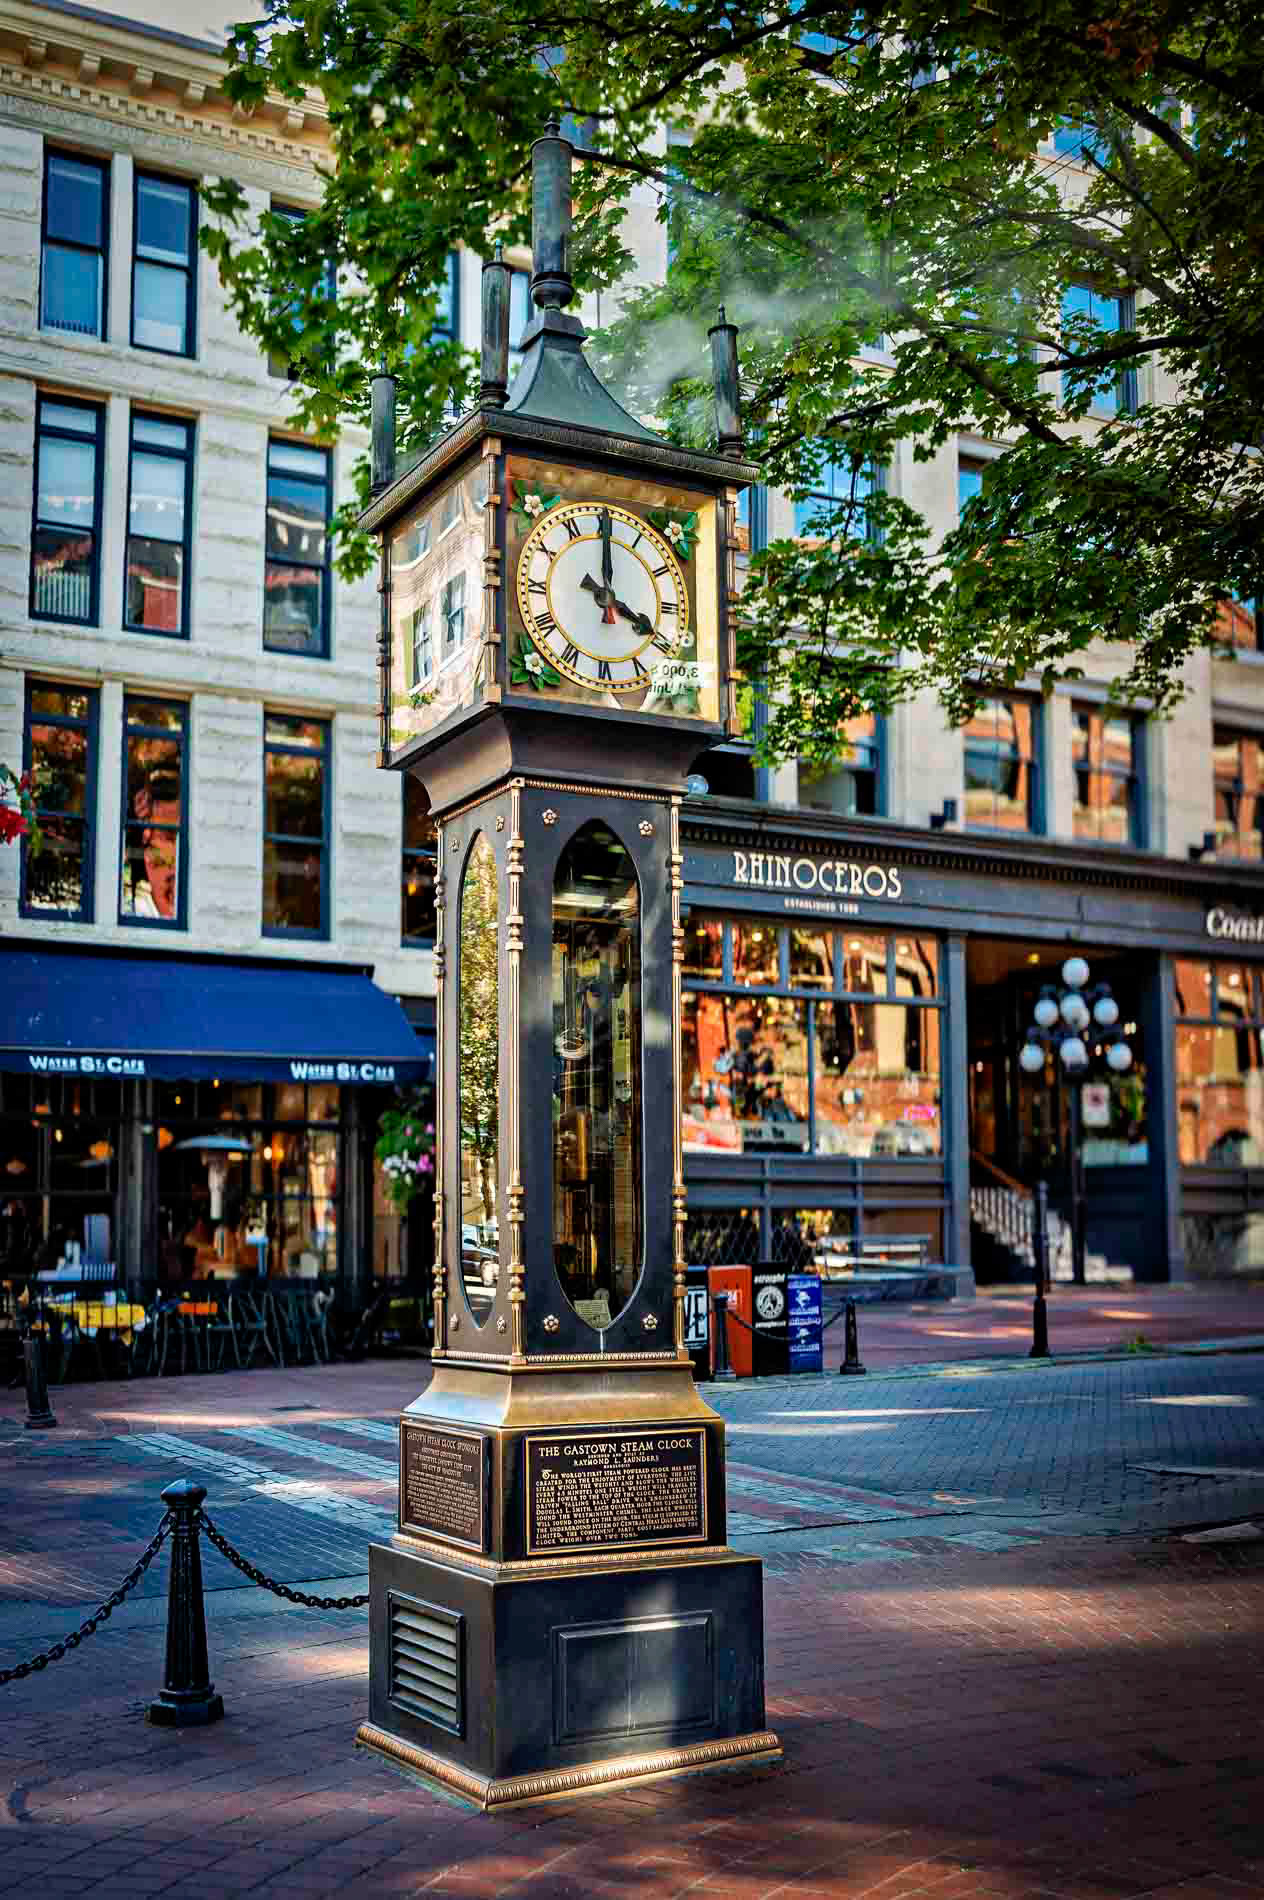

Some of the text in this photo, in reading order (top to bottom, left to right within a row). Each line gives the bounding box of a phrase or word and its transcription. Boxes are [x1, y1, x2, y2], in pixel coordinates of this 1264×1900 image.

[733, 851, 902, 898] RHINOCEROS
[538, 1439, 692, 1456] THE GASTOWN STEAM CLOCK
[573, 1457, 609, 1466] RAYMOND
[623, 1455, 659, 1463] SAUNDERS
